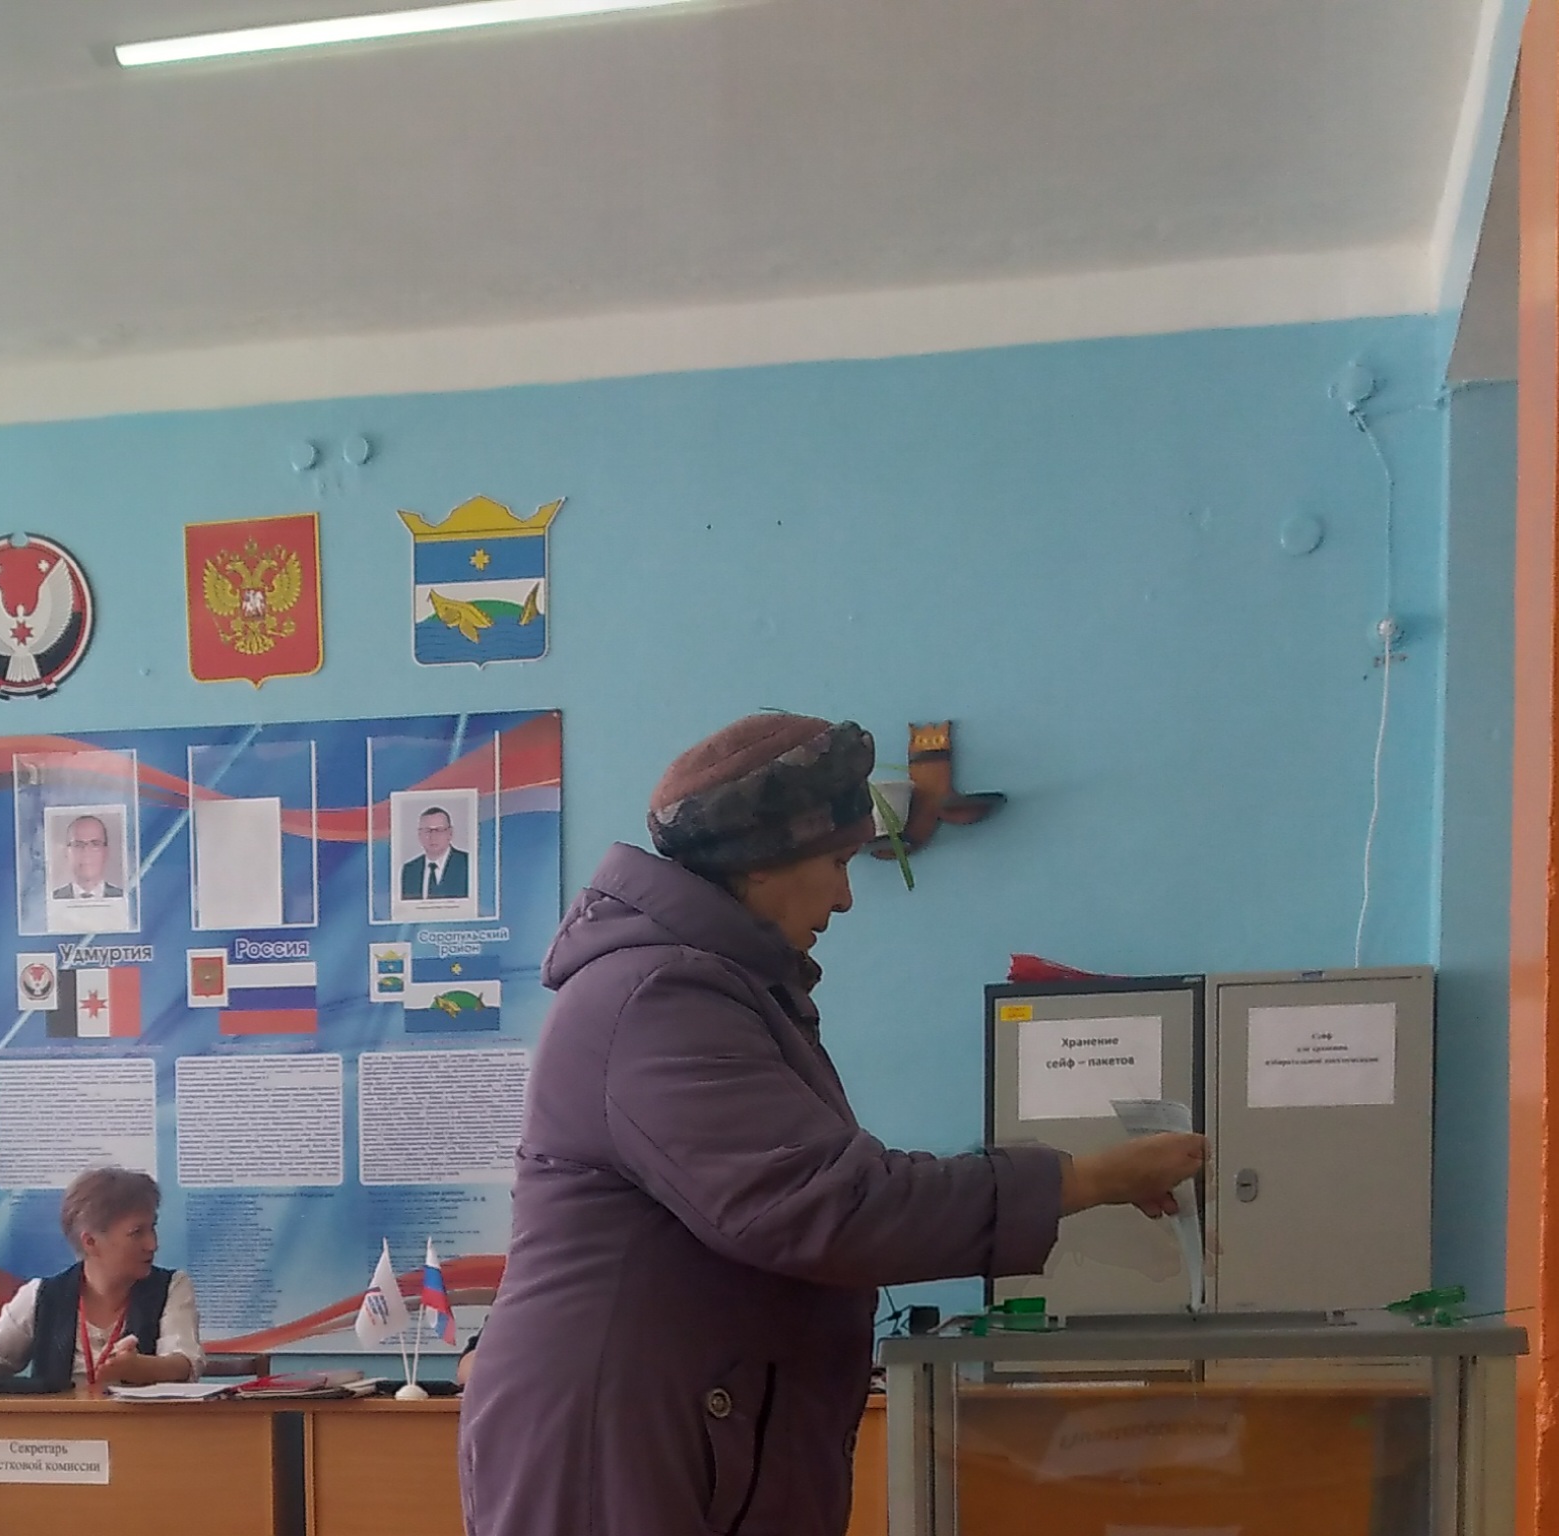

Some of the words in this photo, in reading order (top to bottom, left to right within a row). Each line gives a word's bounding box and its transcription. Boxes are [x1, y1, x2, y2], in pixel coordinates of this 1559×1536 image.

[419, 928, 509, 944] Сарапульский
[59, 943, 153, 966] Удмуртия
[236, 939, 309, 959] Россия
[441, 944, 480, 957] район
[1061, 1037, 1120, 1048] Хранение
[1046, 1058, 1076, 1070] сейф
[1088, 1057, 1135, 1067] пакетов
[9, 1442, 68, 1457] Секретарь
[45, 1460, 101, 1473] комиссии
